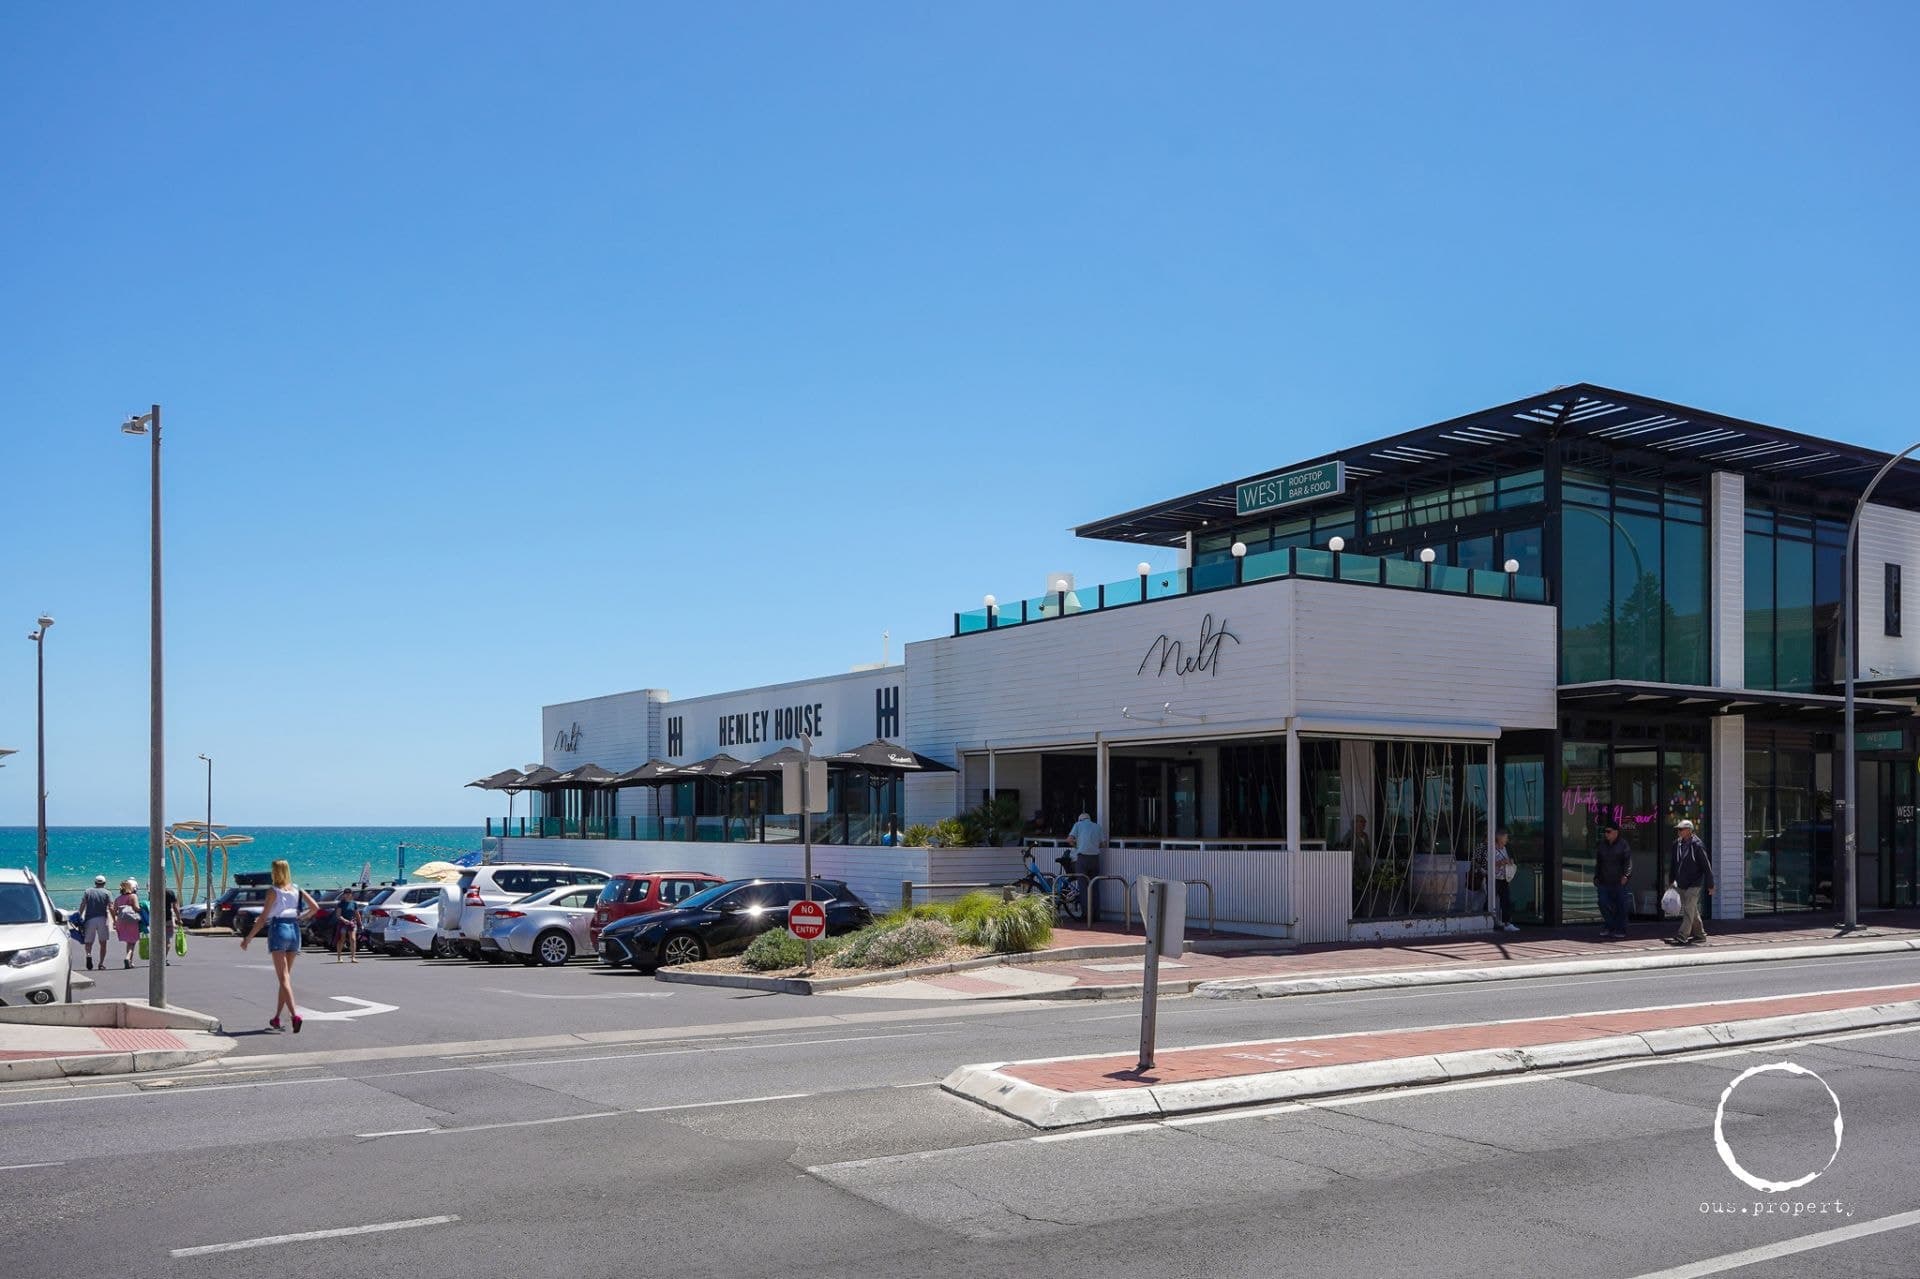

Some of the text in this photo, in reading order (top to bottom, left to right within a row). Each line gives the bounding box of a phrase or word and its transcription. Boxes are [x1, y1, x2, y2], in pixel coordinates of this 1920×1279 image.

[1288, 470, 1323, 487] ROOFTOP
[1243, 480, 1284, 508] WEST
[1288, 480, 1331, 498] BAR & FOOD
[719, 703, 823, 747] HENLEY HOUSE
[1896, 805, 1915, 817] WEST
[800, 905, 814, 914] NO
[796, 926, 820, 934] ENTRY
